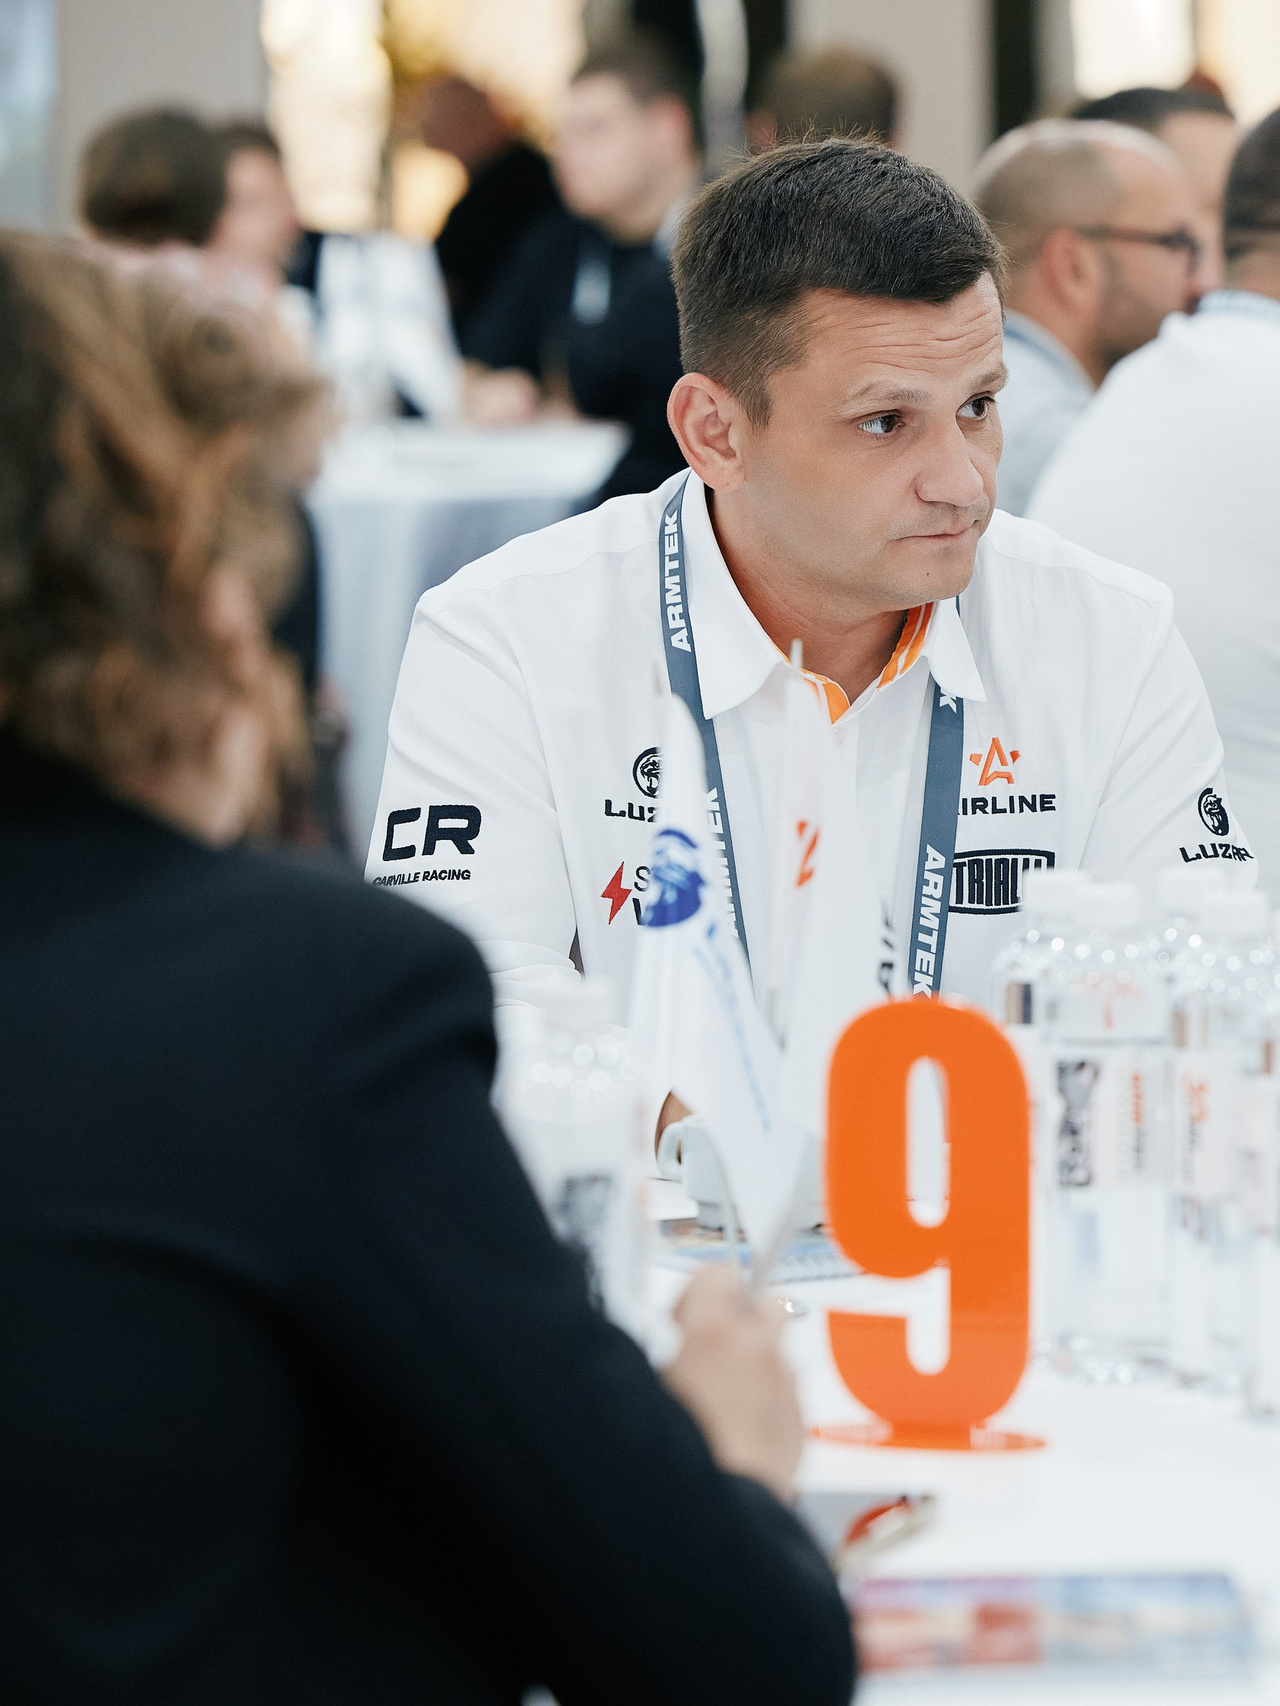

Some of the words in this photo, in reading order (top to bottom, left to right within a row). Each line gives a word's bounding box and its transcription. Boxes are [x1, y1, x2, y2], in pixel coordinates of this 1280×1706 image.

[664, 510, 692, 653] ARMTEK
[604, 799, 661, 822] LUZ
[958, 794, 1056, 816] IRLINE
[382, 804, 482, 861] CR
[1179, 842, 1255, 863] LUZAR
[422, 869, 471, 881] RACING
[953, 857, 1043, 907] TRIAL
[913, 843, 946, 1000] ARMTEK
[826, 998, 1031, 1426] 9
